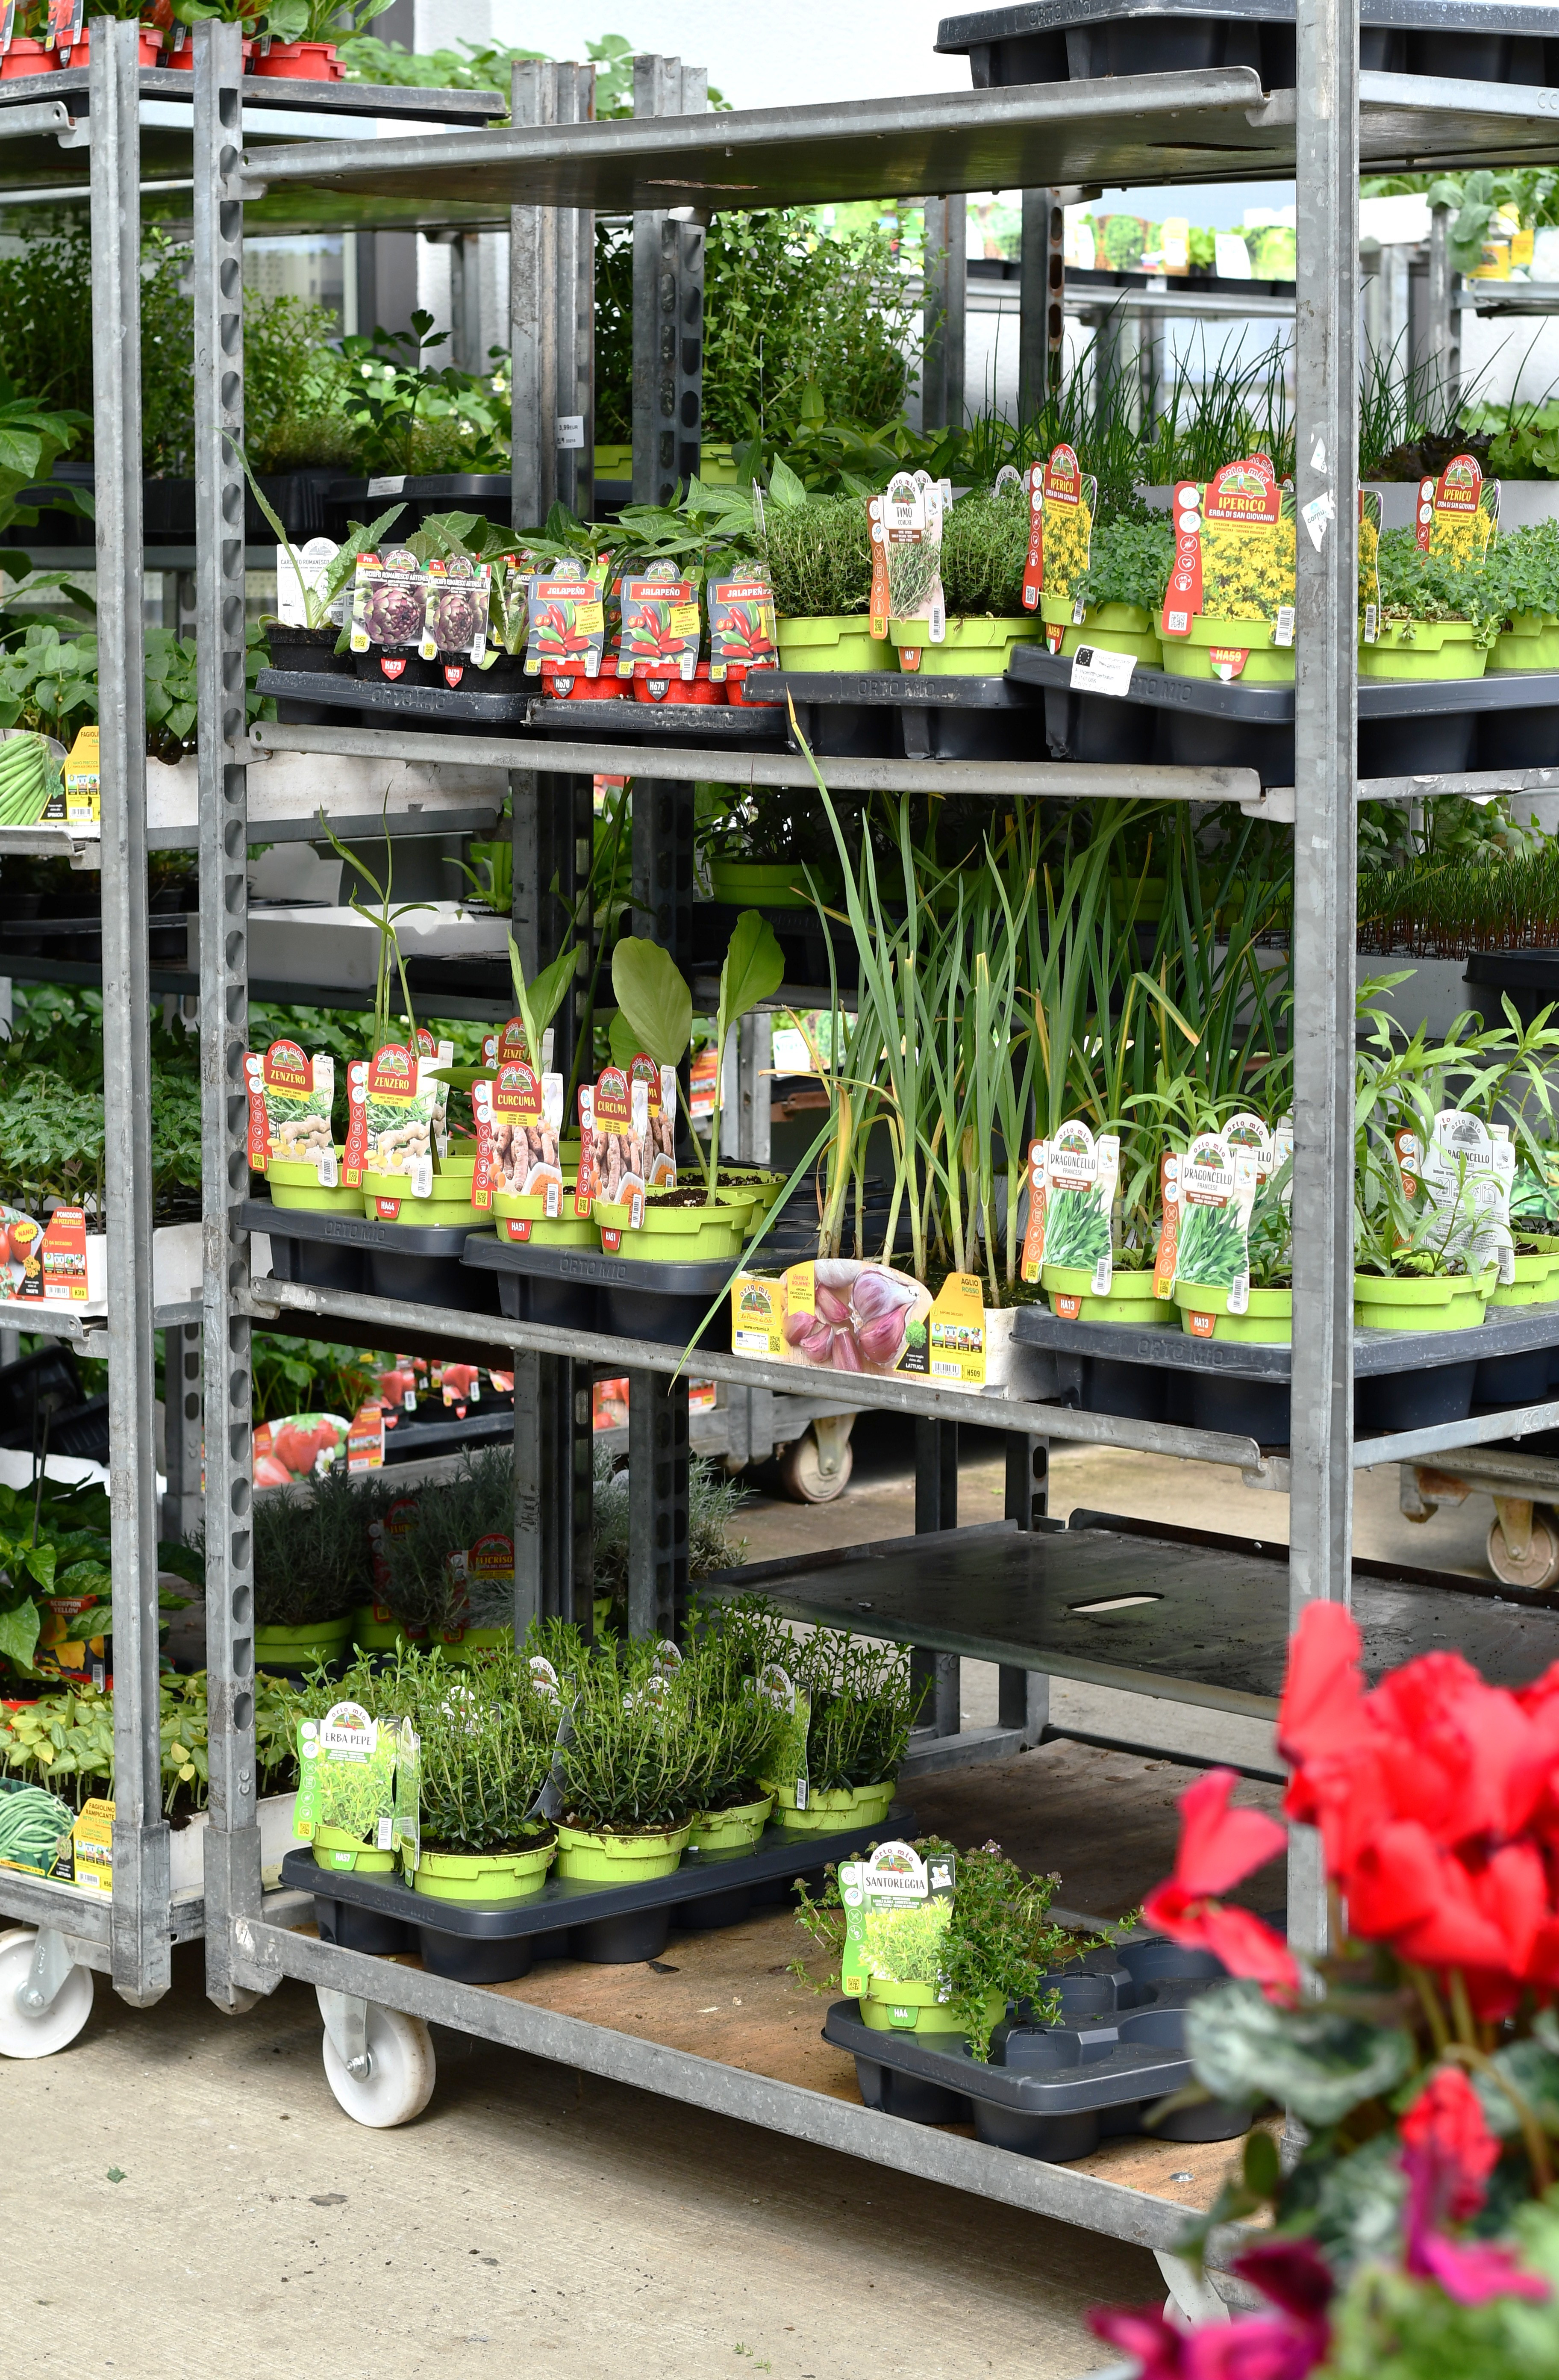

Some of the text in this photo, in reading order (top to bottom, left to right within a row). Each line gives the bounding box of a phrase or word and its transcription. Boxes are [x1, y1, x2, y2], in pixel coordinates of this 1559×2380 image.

[1220, 466, 1270, 484] orto mio
[891, 479, 902, 492] orto
[1050, 477, 1074, 494] IPERICO
[1444, 489, 1471, 502] IPERICO
[1219, 497, 1266, 513] IPERICO
[896, 507, 912, 518] TIMO
[1209, 509, 1224, 517] ERBA
[1247, 513, 1274, 521] GIOVANNI
[382, 571, 409, 580] ROMANESCO
[547, 586, 585, 595] JALAPEÑO
[641, 587, 680, 596] JALAPEÑO
[727, 586, 769, 597] JALAPEÑ
[1047, 627, 1060, 638] HA59
[905, 651, 915, 661] HA7
[1216, 649, 1242, 662] HA59
[385, 661, 401, 670] H673
[447, 669, 459, 678] H673
[556, 678, 570, 689] H678
[650, 681, 665, 691] H678
[271, 1046, 303, 1061] orto mio
[378, 1050, 409, 1065] orto mio
[503, 1049, 530, 1060] ZENZE
[271, 1069, 306, 1085] ZENZERO
[501, 1066, 532, 1083] orto mio
[374, 1076, 409, 1090] ZENZERO
[497, 1094, 536, 1107] CURCUMA
[598, 1101, 627, 1115] CURCUMA
[1227, 1121, 1263, 1136] orto mio
[1451, 1119, 1481, 1133] orto mio
[1059, 1128, 1089, 1143] orto mio
[1194, 1142, 1225, 1157] orto mio
[1050, 1154, 1096, 1169] DRAGONCELLO
[1443, 1149, 1490, 1164] RAGNCELLO
[1184, 1167, 1232, 1185] DRAGONCELLO
[1197, 1183, 1218, 1191] FRANCESE
[381, 1201, 395, 1211] HA44
[18, 1228, 33, 1237] NANO
[511, 1222, 525, 1232] HA51
[605, 1231, 616, 1242] HA51
[560, 1256, 596, 1275] ORTO
[961, 1278, 979, 1287] AGLIO
[740, 1284, 771, 1301] orto mio
[1060, 1299, 1075, 1311] HA13
[1194, 1316, 1209, 1329] HA13
[967, 1369, 980, 1377] H509
[332, 1708, 366, 1720] orto mio
[326, 1732, 371, 1746] ERBA PEPE
[89, 1803, 115, 1813] FAGIOLINO
[85, 1809, 114, 1820] RAMPICANTE
[335, 1852, 350, 1862] HA57
[874, 1849, 913, 1862] orto mio
[866, 1876, 925, 1889] SANTOREGGIA
[894, 2008, 908, 2018] HA4
